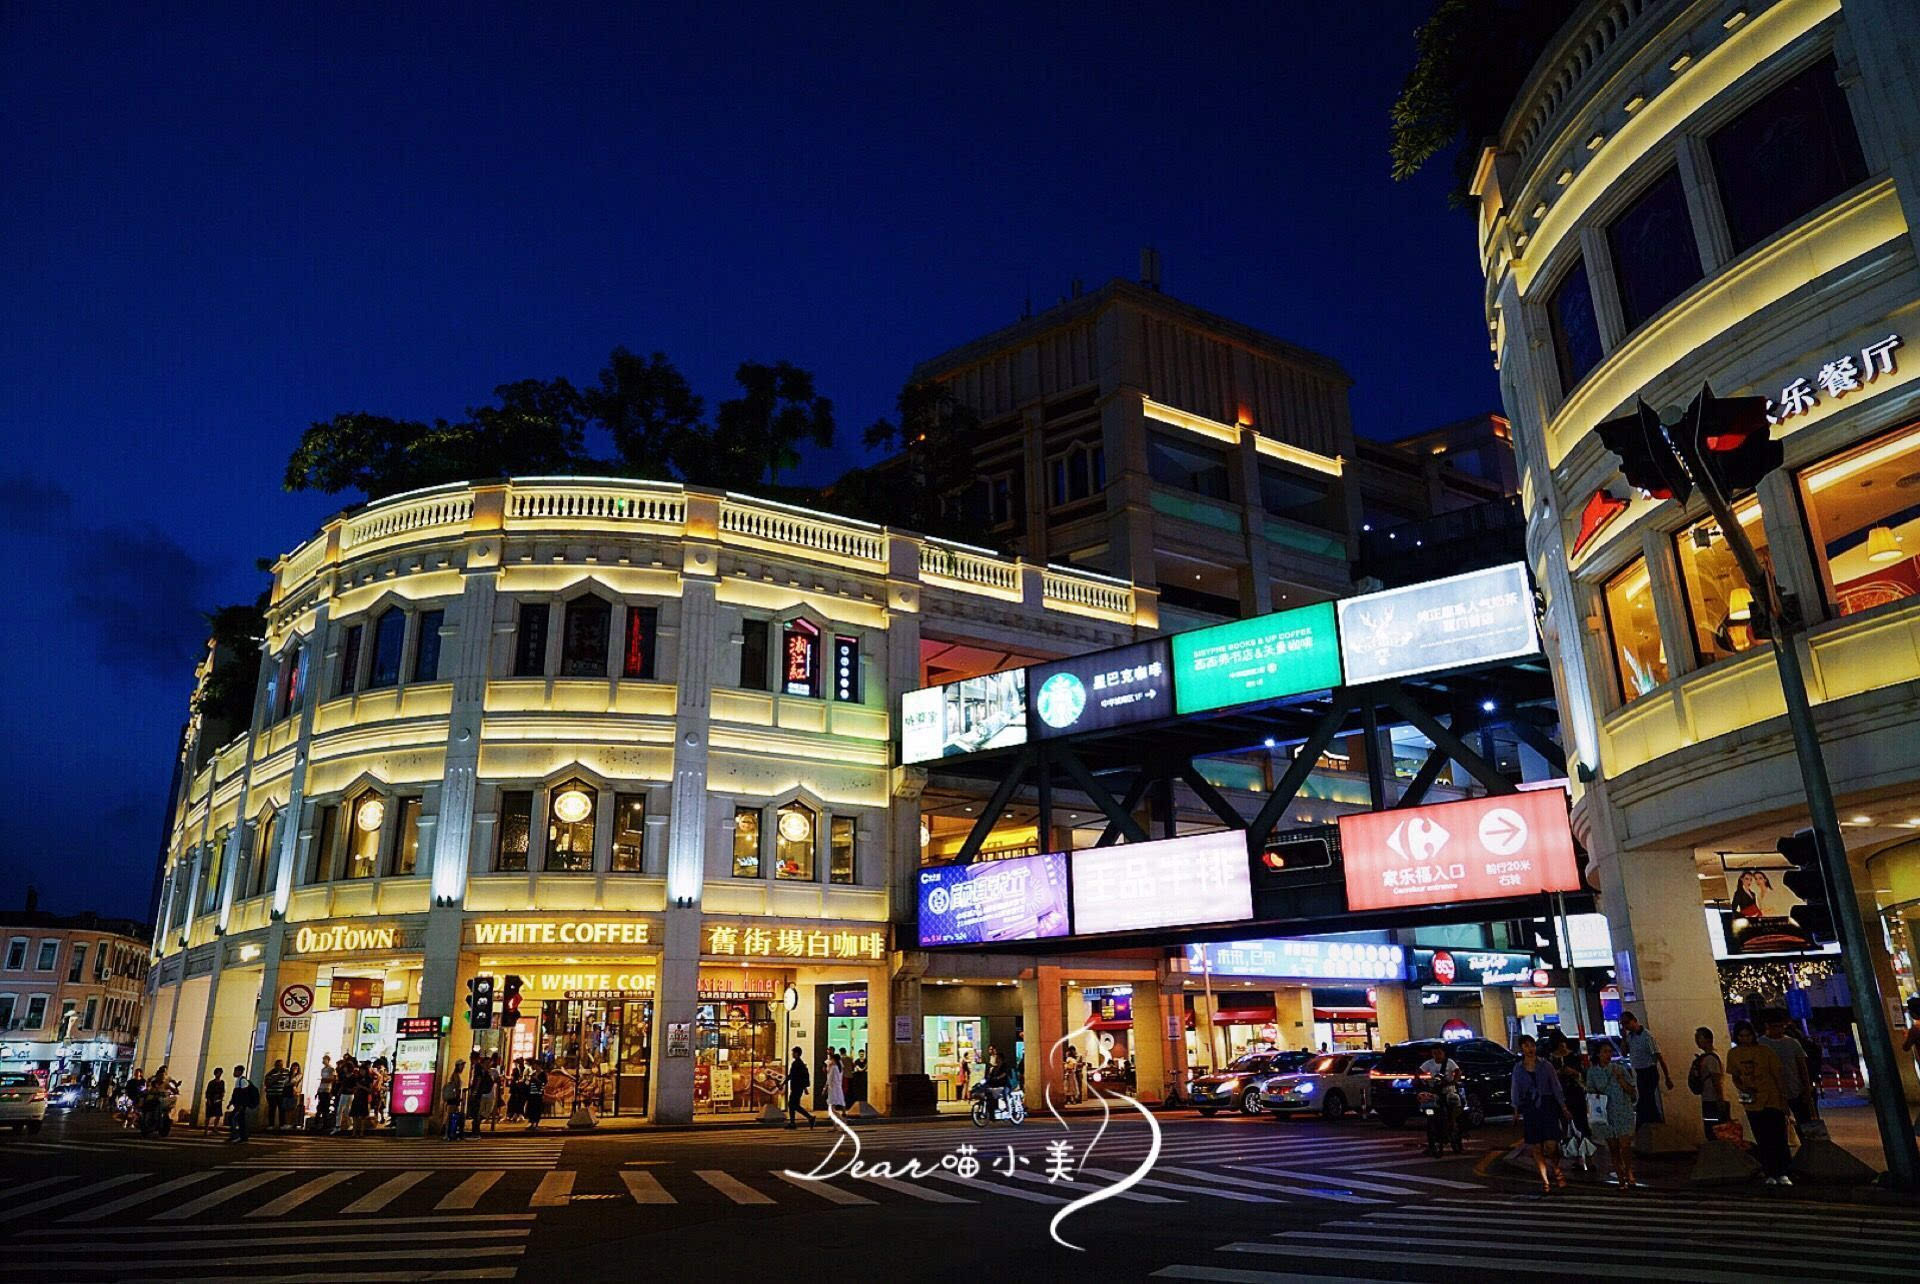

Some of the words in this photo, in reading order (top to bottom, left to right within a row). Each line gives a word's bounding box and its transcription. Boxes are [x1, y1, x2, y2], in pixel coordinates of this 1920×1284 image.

[1093, 661, 1162, 690] 星巴克咖啡
[1382, 863, 1465, 887] 家乐福入口
[474, 923, 556, 944] WHITE
[559, 922, 649, 944] COFFEE
[708, 926, 885, 959] 舊街場白咖啡
[541, 974, 611, 991] WHITE
